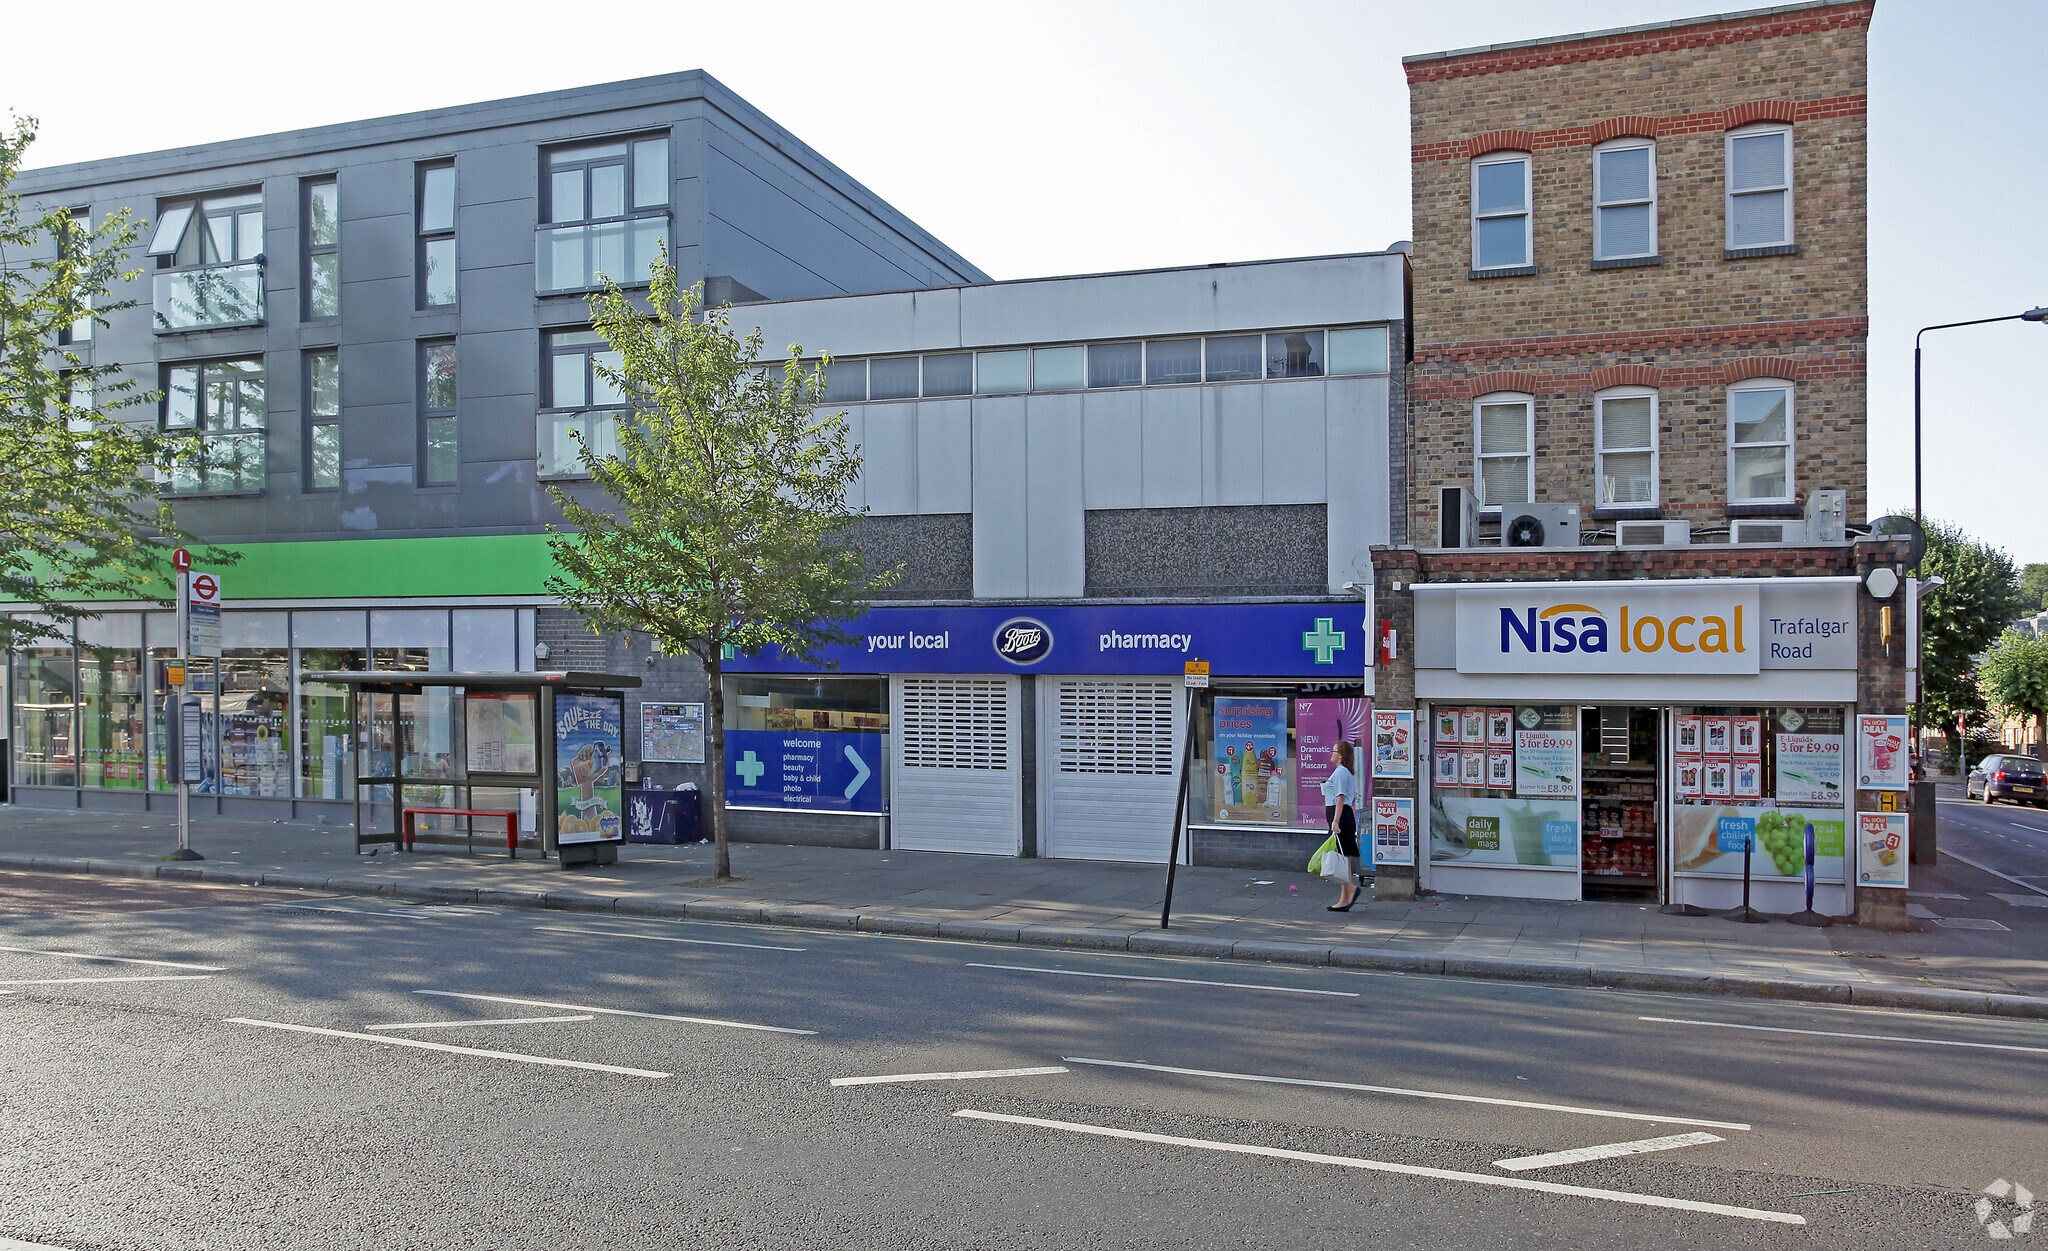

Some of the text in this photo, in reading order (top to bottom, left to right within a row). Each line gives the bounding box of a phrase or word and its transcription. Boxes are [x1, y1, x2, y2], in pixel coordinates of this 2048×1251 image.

[179, 551, 188, 567] L
[1499, 604, 1746, 654] Nisa local
[1770, 618, 1849, 638] Trafalgar
[867, 630, 949, 653] your local
[1001, 627, 1042, 653] Boots
[1099, 630, 1192, 653] pharmacy
[1771, 643, 1812, 659] Road
[1219, 704, 1274, 719] surprising
[557, 706, 603, 740] SQUEEZE
[1219, 718, 1253, 730] prices
[584, 719, 619, 738] THE DAY
[1863, 725, 1887, 734] DEAL
[1300, 736, 1320, 744] NEW
[1519, 732, 1549, 740] E-Liquids
[1780, 735, 1813, 744] E-Liquids
[783, 739, 821, 749] welcome
[1519, 739, 1526, 748] 3
[1528, 739, 1541, 748] for
[1543, 738, 1573, 749] £9.99
[1780, 743, 1840, 753] 3 for £9.99
[1300, 745, 1330, 753] Dramatic
[783, 753, 814, 763] pharmacy
[783, 763, 804, 773] beauty
[783, 774, 821, 784] baby & child
[783, 784, 802, 794] photo
[1547, 784, 1573, 793] £8.99
[783, 794, 812, 804] electrical
[1811, 791, 1840, 800] £8.99
[1880, 794, 1893, 811] H
[1469, 819, 1492, 830] daily
[1546, 824, 1571, 833] fresh
[1720, 819, 1748, 830] fresh
[1863, 823, 1886, 831] DEAL
[1470, 830, 1497, 839] papers
[1552, 834, 1572, 844] dairy
[1722, 831, 1751, 840] chilled
[1478, 839, 1498, 849] mags
[1886, 836, 1899, 847] £1
[1549, 844, 1577, 853] produce
